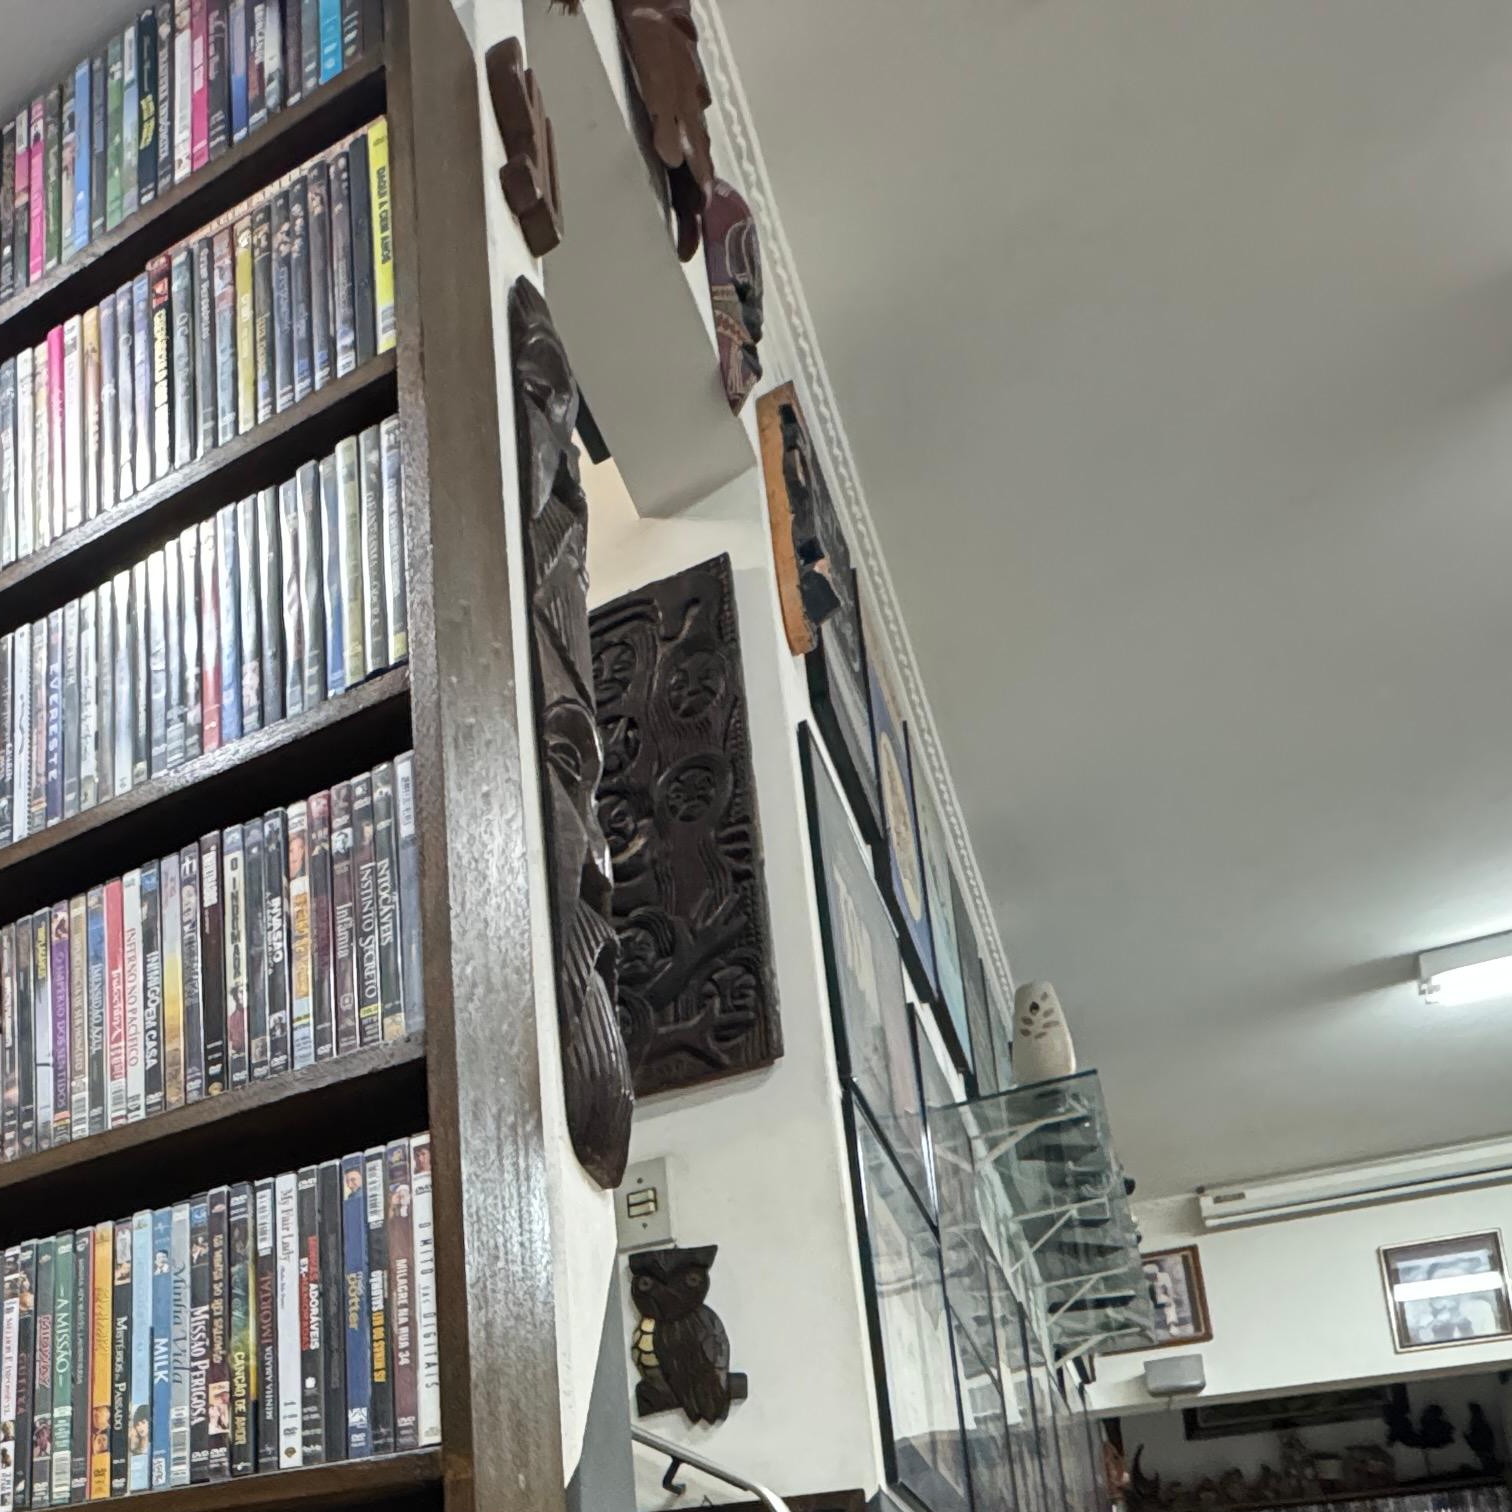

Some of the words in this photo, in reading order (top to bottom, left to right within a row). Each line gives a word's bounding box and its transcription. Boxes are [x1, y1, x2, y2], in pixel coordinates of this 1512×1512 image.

[359, 861, 376, 932] INSTINTO
[378, 859, 395, 945] INTOCÁVEIS
[336, 903, 354, 958] Infâmia
[359, 935, 378, 998] SECRETO
[127, 986, 137, 1005] NO
[144, 1007, 156, 1027] EM
[127, 1008, 141, 1067] PACÍFICO
[145, 1030, 158, 1070] CASA
[279, 1188, 294, 1206] My
[280, 1209, 293, 1228] Fair
[280, 1231, 293, 1263] Lady
[419, 1240, 433, 1276] MITO
[172, 1262, 187, 1326] Minha
[396, 1259, 409, 1305] MILAGRE
[190, 1304, 209, 1357] MISSÃO
[308, 1283, 319, 1350] ADORÁVEIS
[397, 1308, 409, 1323] NA
[398, 1327, 409, 1347] RUA
[56, 1314, 71, 1373] MISSÃO
[153, 1338, 168, 1384] MILK
[172, 1332, 189, 1385] Vida
[398, 1350, 410, 1366] 34
[113, 1382, 127, 1431] PASSADO
[190, 1360, 209, 1426] PERIGOSA
[234, 1400, 246, 1413] DE
